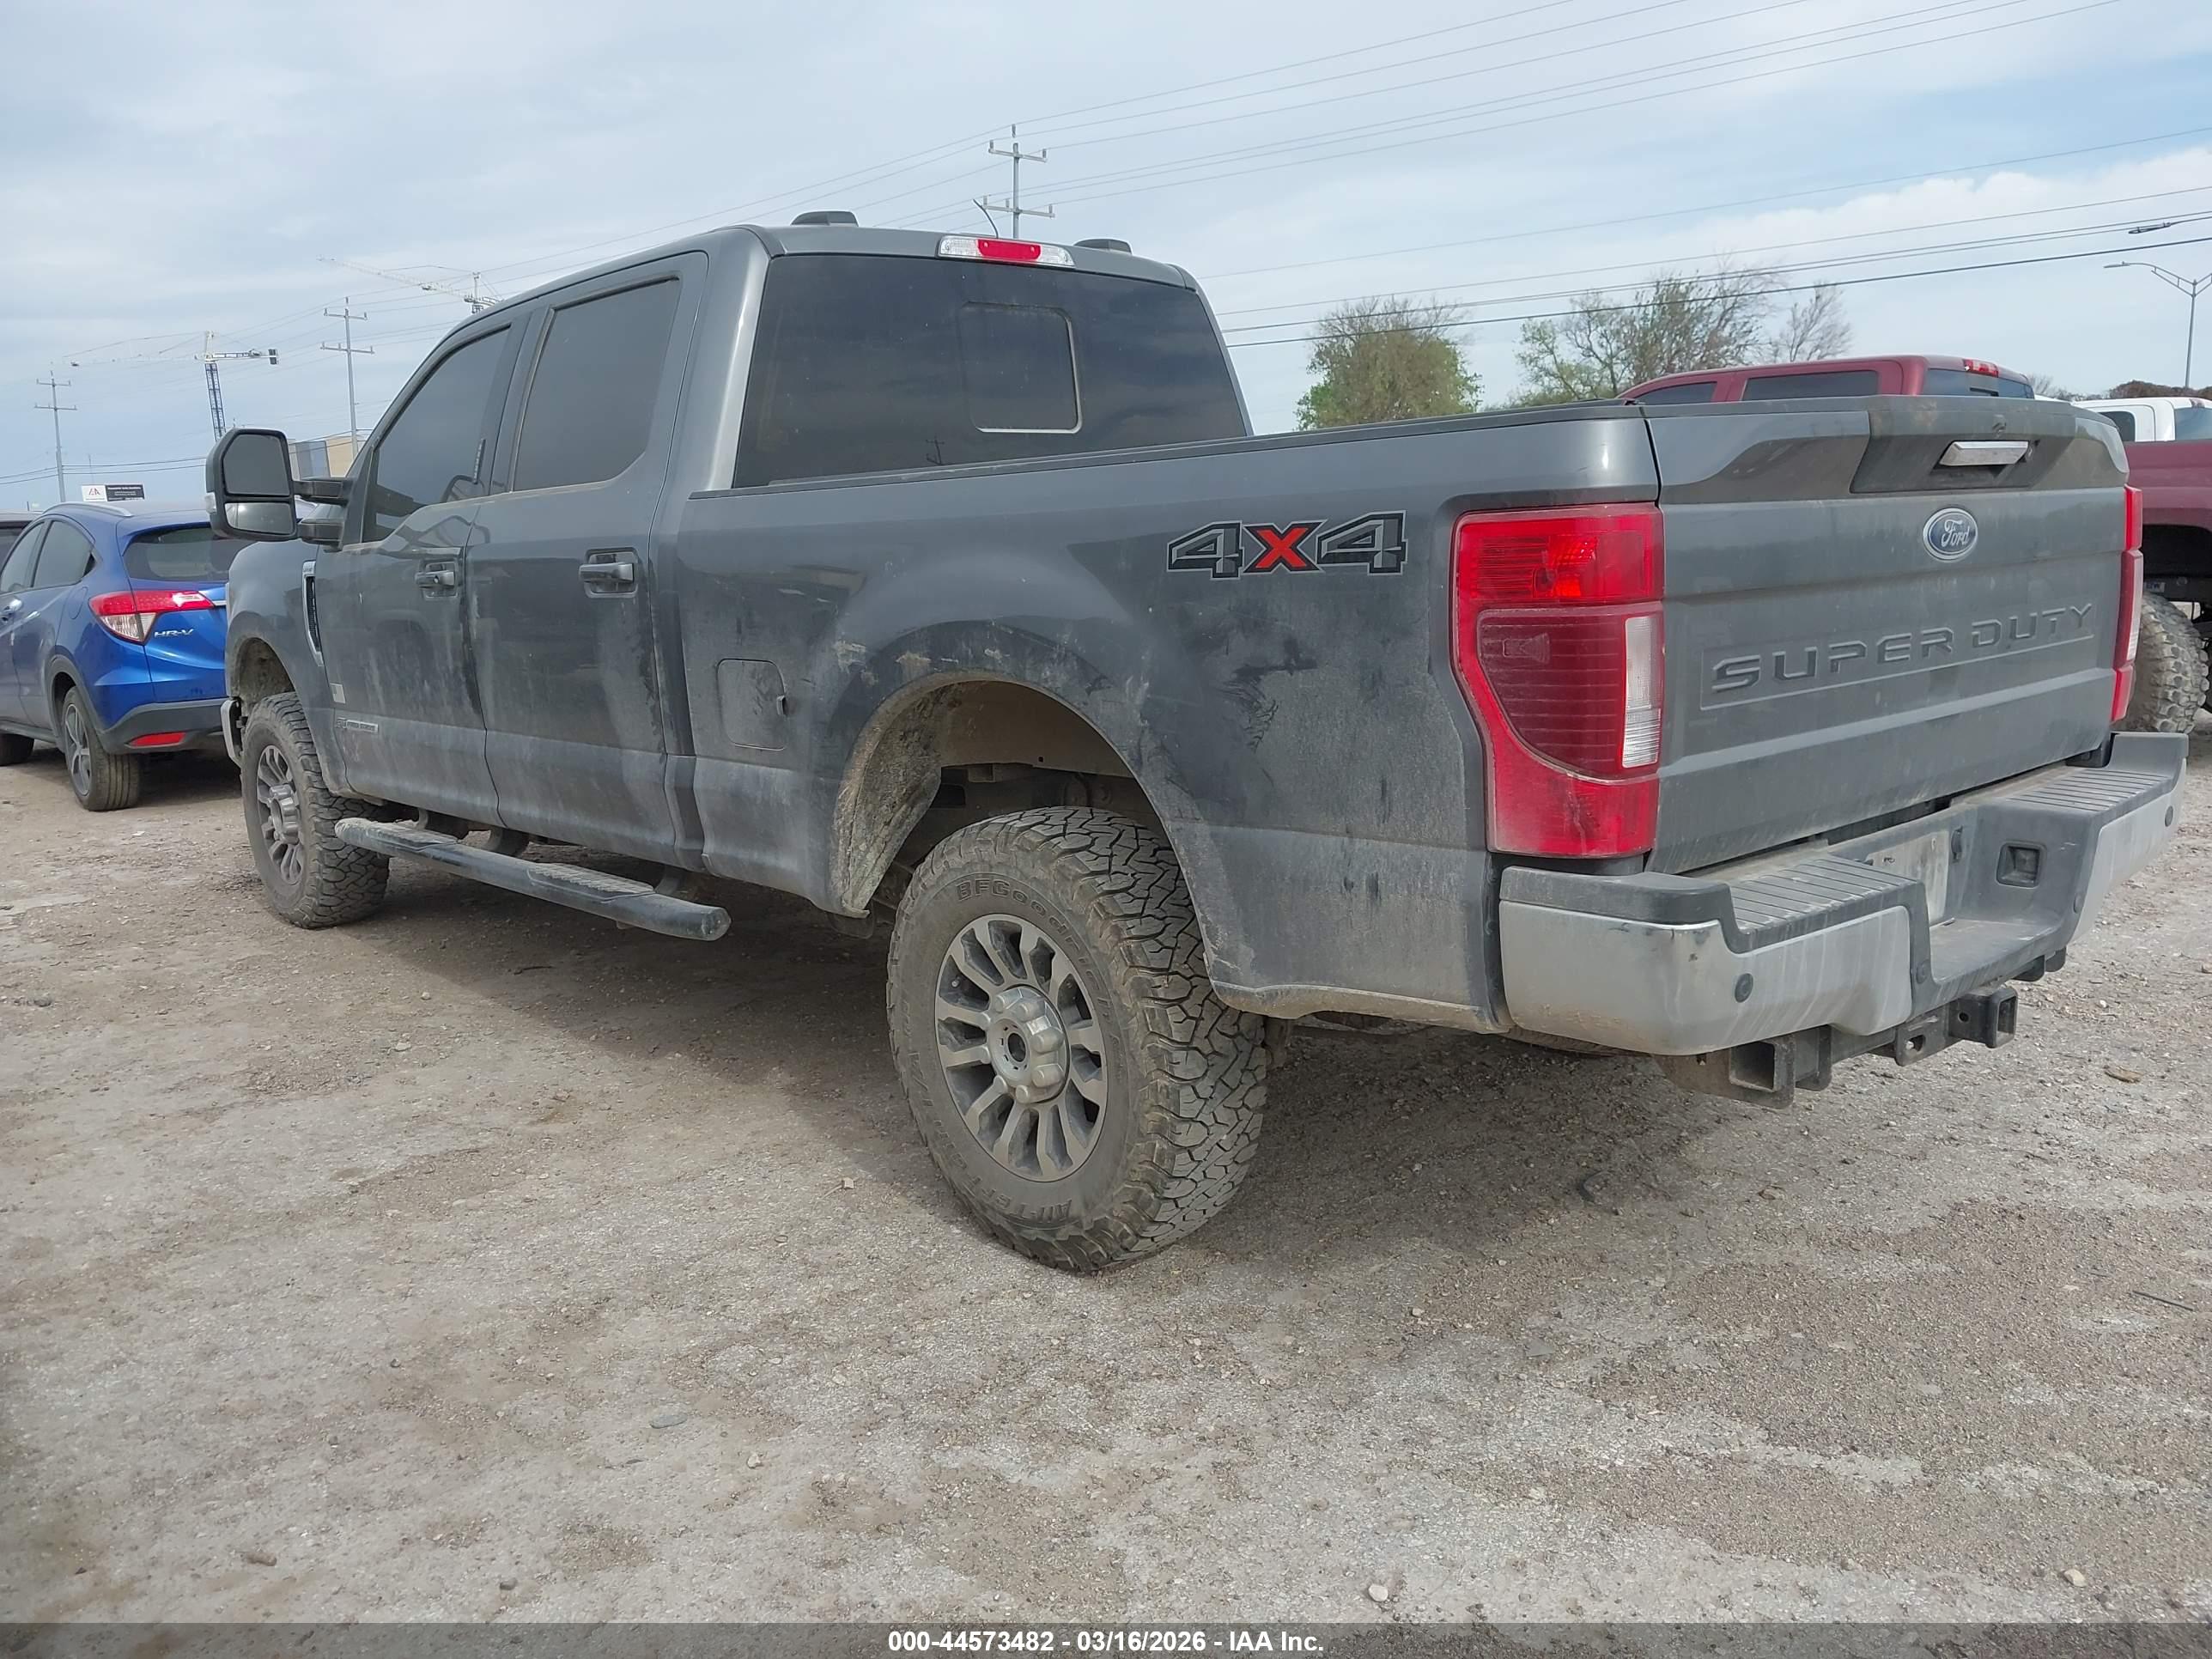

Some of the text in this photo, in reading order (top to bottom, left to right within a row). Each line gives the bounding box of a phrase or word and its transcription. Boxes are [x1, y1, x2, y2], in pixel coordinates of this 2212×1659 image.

[1941, 519, 1971, 547] Ford
[154, 629, 194, 638] HR-V
[1712, 602, 2093, 693] SUPER DUTY
[955, 878, 1113, 1022] BFGoodrich
